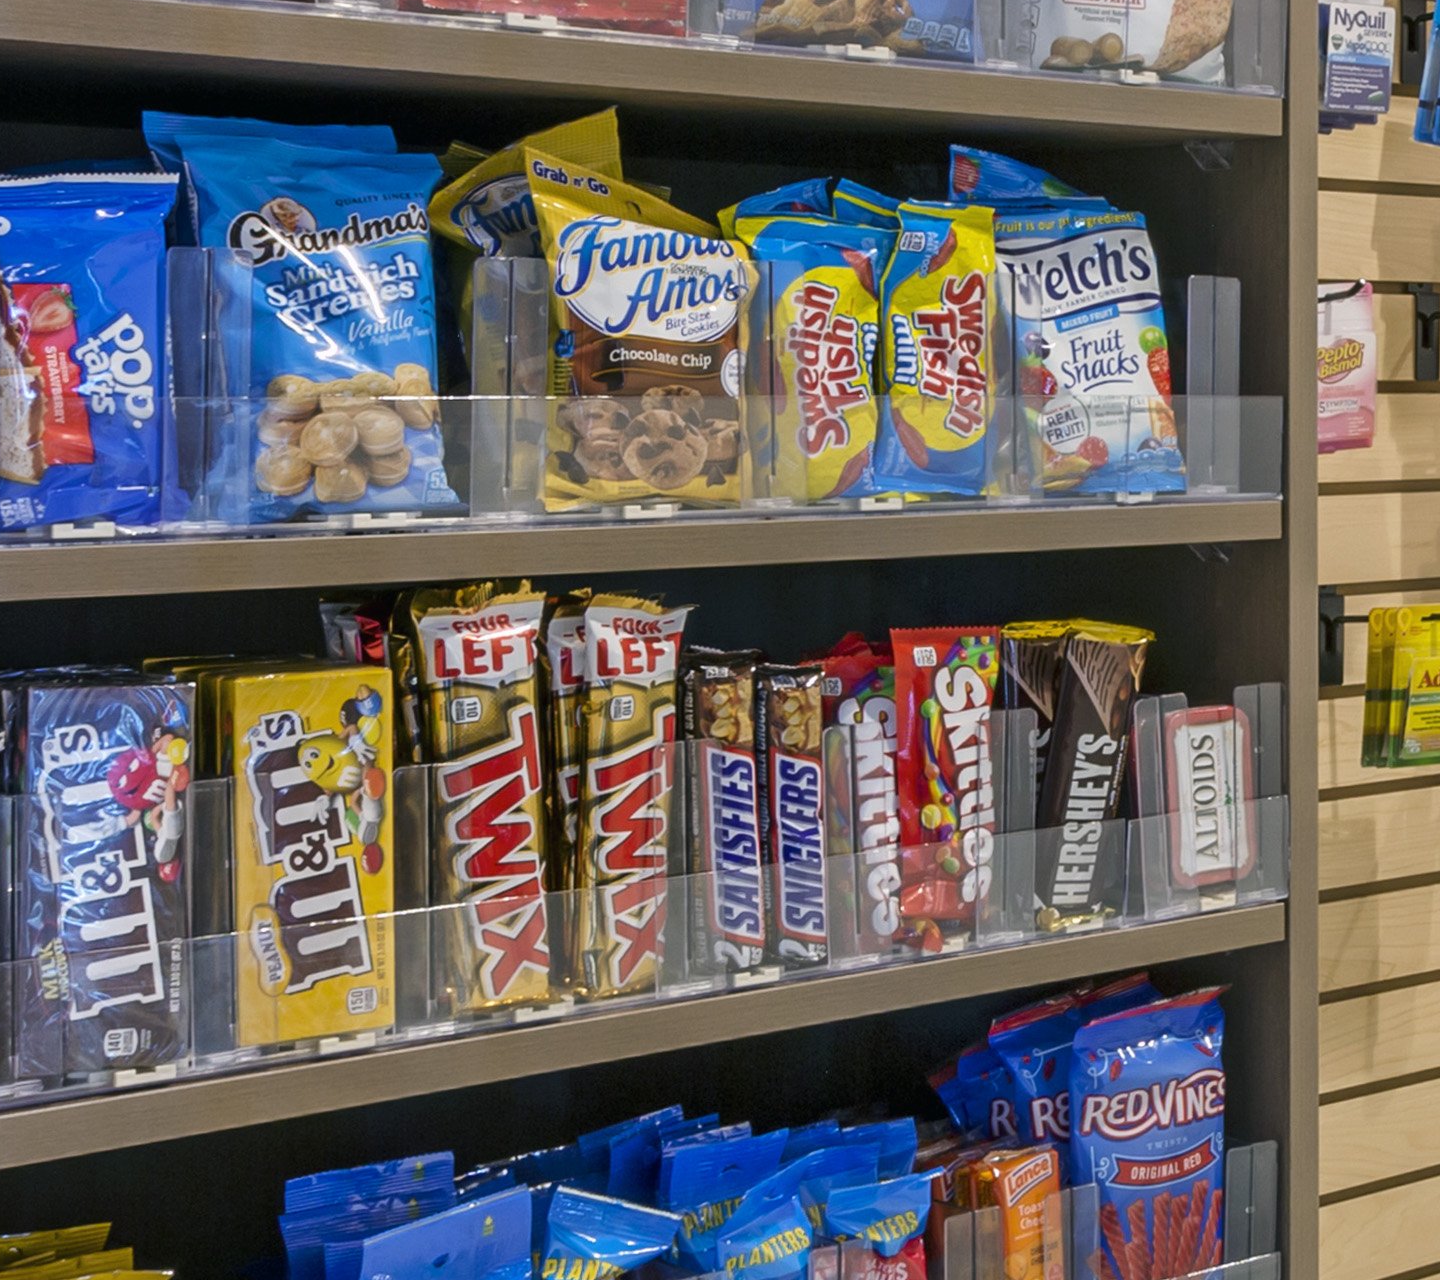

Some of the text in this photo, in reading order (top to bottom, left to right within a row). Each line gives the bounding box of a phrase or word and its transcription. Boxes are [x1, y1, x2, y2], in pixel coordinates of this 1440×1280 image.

[1334, 7, 1386, 32] NyQuil
[533, 161, 568, 185] Grab
[588, 178, 609, 195] Go
[227, 204, 428, 266] Grandma's
[555, 219, 734, 296] Famous
[286, 263, 333, 286] Mini
[604, 269, 740, 334] Amos
[349, 310, 413, 342] Vanilla
[665, 312, 711, 330] Bite Size
[1069, 330, 1125, 361] Fruit
[610, 349, 711, 369] Chocolate Chip
[789, 282, 848, 457] Swedish
[823, 315, 869, 419] Fish
[891, 314, 915, 387] mini
[915, 310, 956, 400] Fish
[942, 271, 987, 438] Swedish
[1061, 352, 1139, 394] Snacks
[1319, 354, 1363, 380] Bismol
[45, 346, 65, 424] STRAWBERRY
[1047, 408, 1080, 428] REAL
[434, 627, 537, 680] LEFT
[452, 615, 510, 634] FOUR
[1052, 732, 1118, 905] HERSHEY'S
[1191, 732, 1220, 862] ALTOIDS
[444, 712, 549, 995] TWIX
[778, 757, 827, 939] SNICKERS
[256, 920, 287, 982] PEANUT
[1004, 1158, 1051, 1198] Lance
[725, 1225, 811, 1279] PLANTERS
